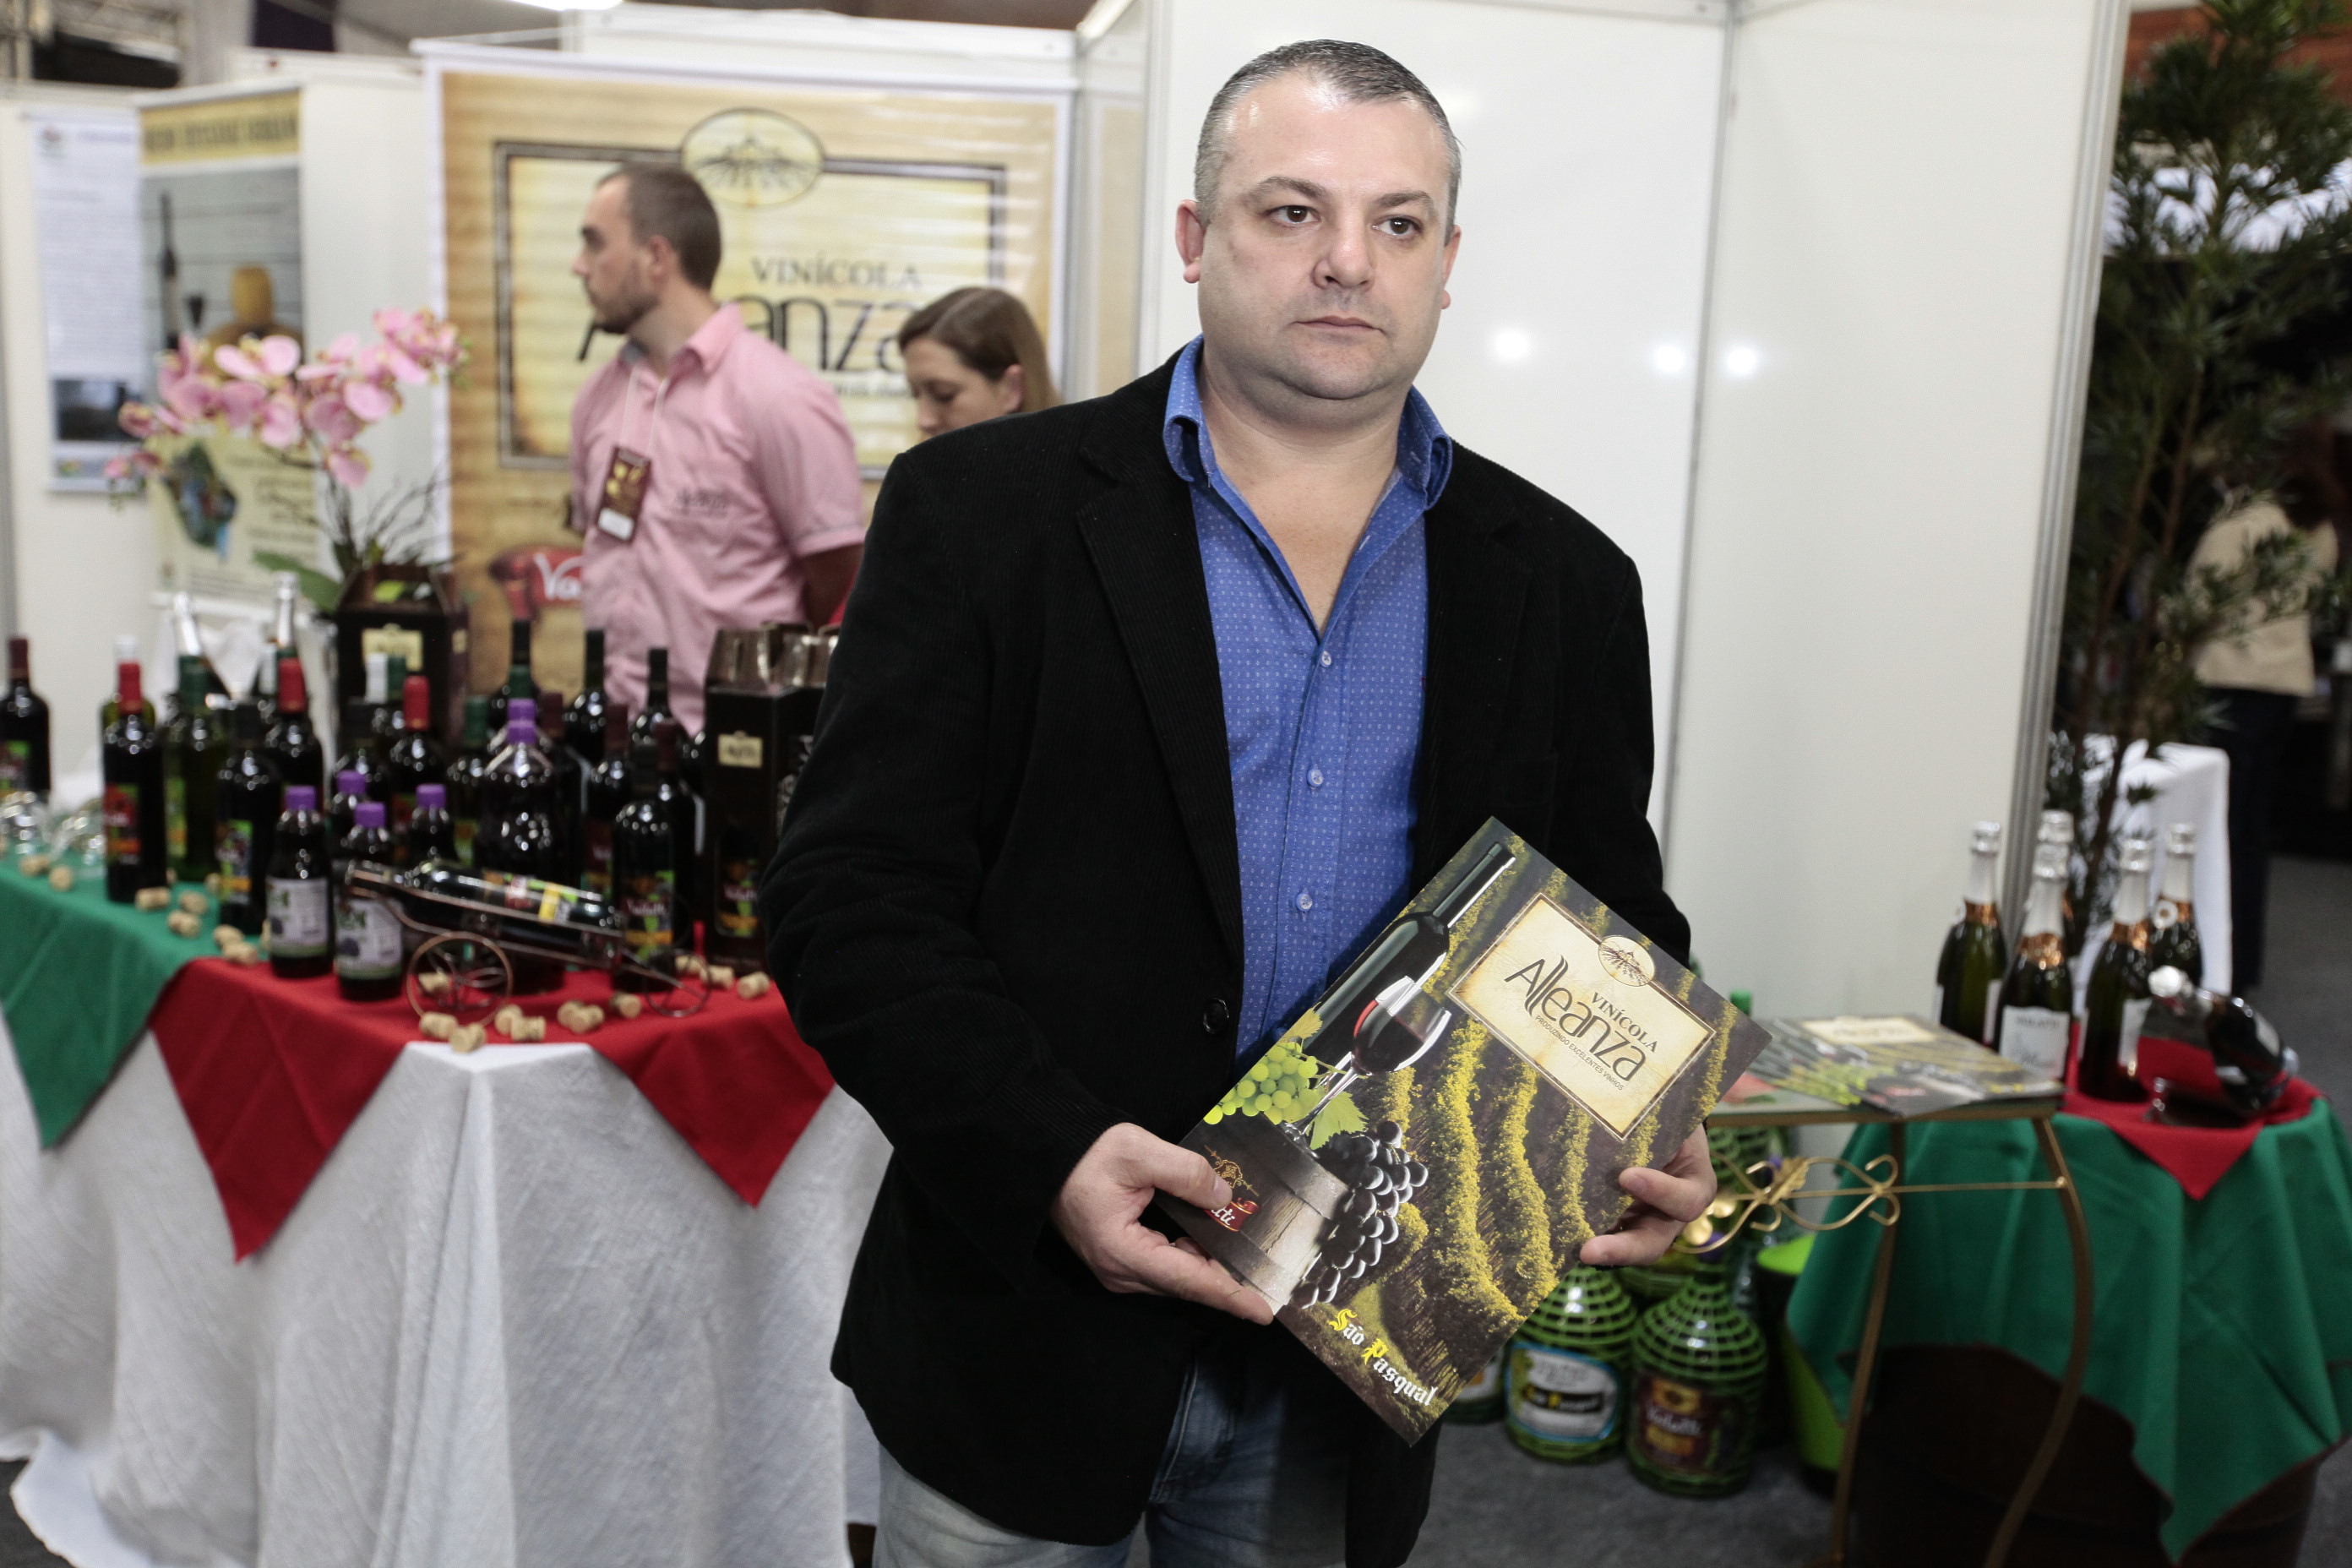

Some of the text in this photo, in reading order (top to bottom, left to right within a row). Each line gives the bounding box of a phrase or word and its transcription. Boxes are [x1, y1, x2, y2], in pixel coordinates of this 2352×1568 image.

[752, 254, 923, 290] VINÍCOLA
[1504, 954, 1647, 1082] Alleanza
[1534, 1015, 1625, 1091] PRODUZINDO EXCELENTES VINHOS
[1591, 991, 1659, 1054] VINÍCOLA
[1361, 1337, 1438, 1407] Pasqual
